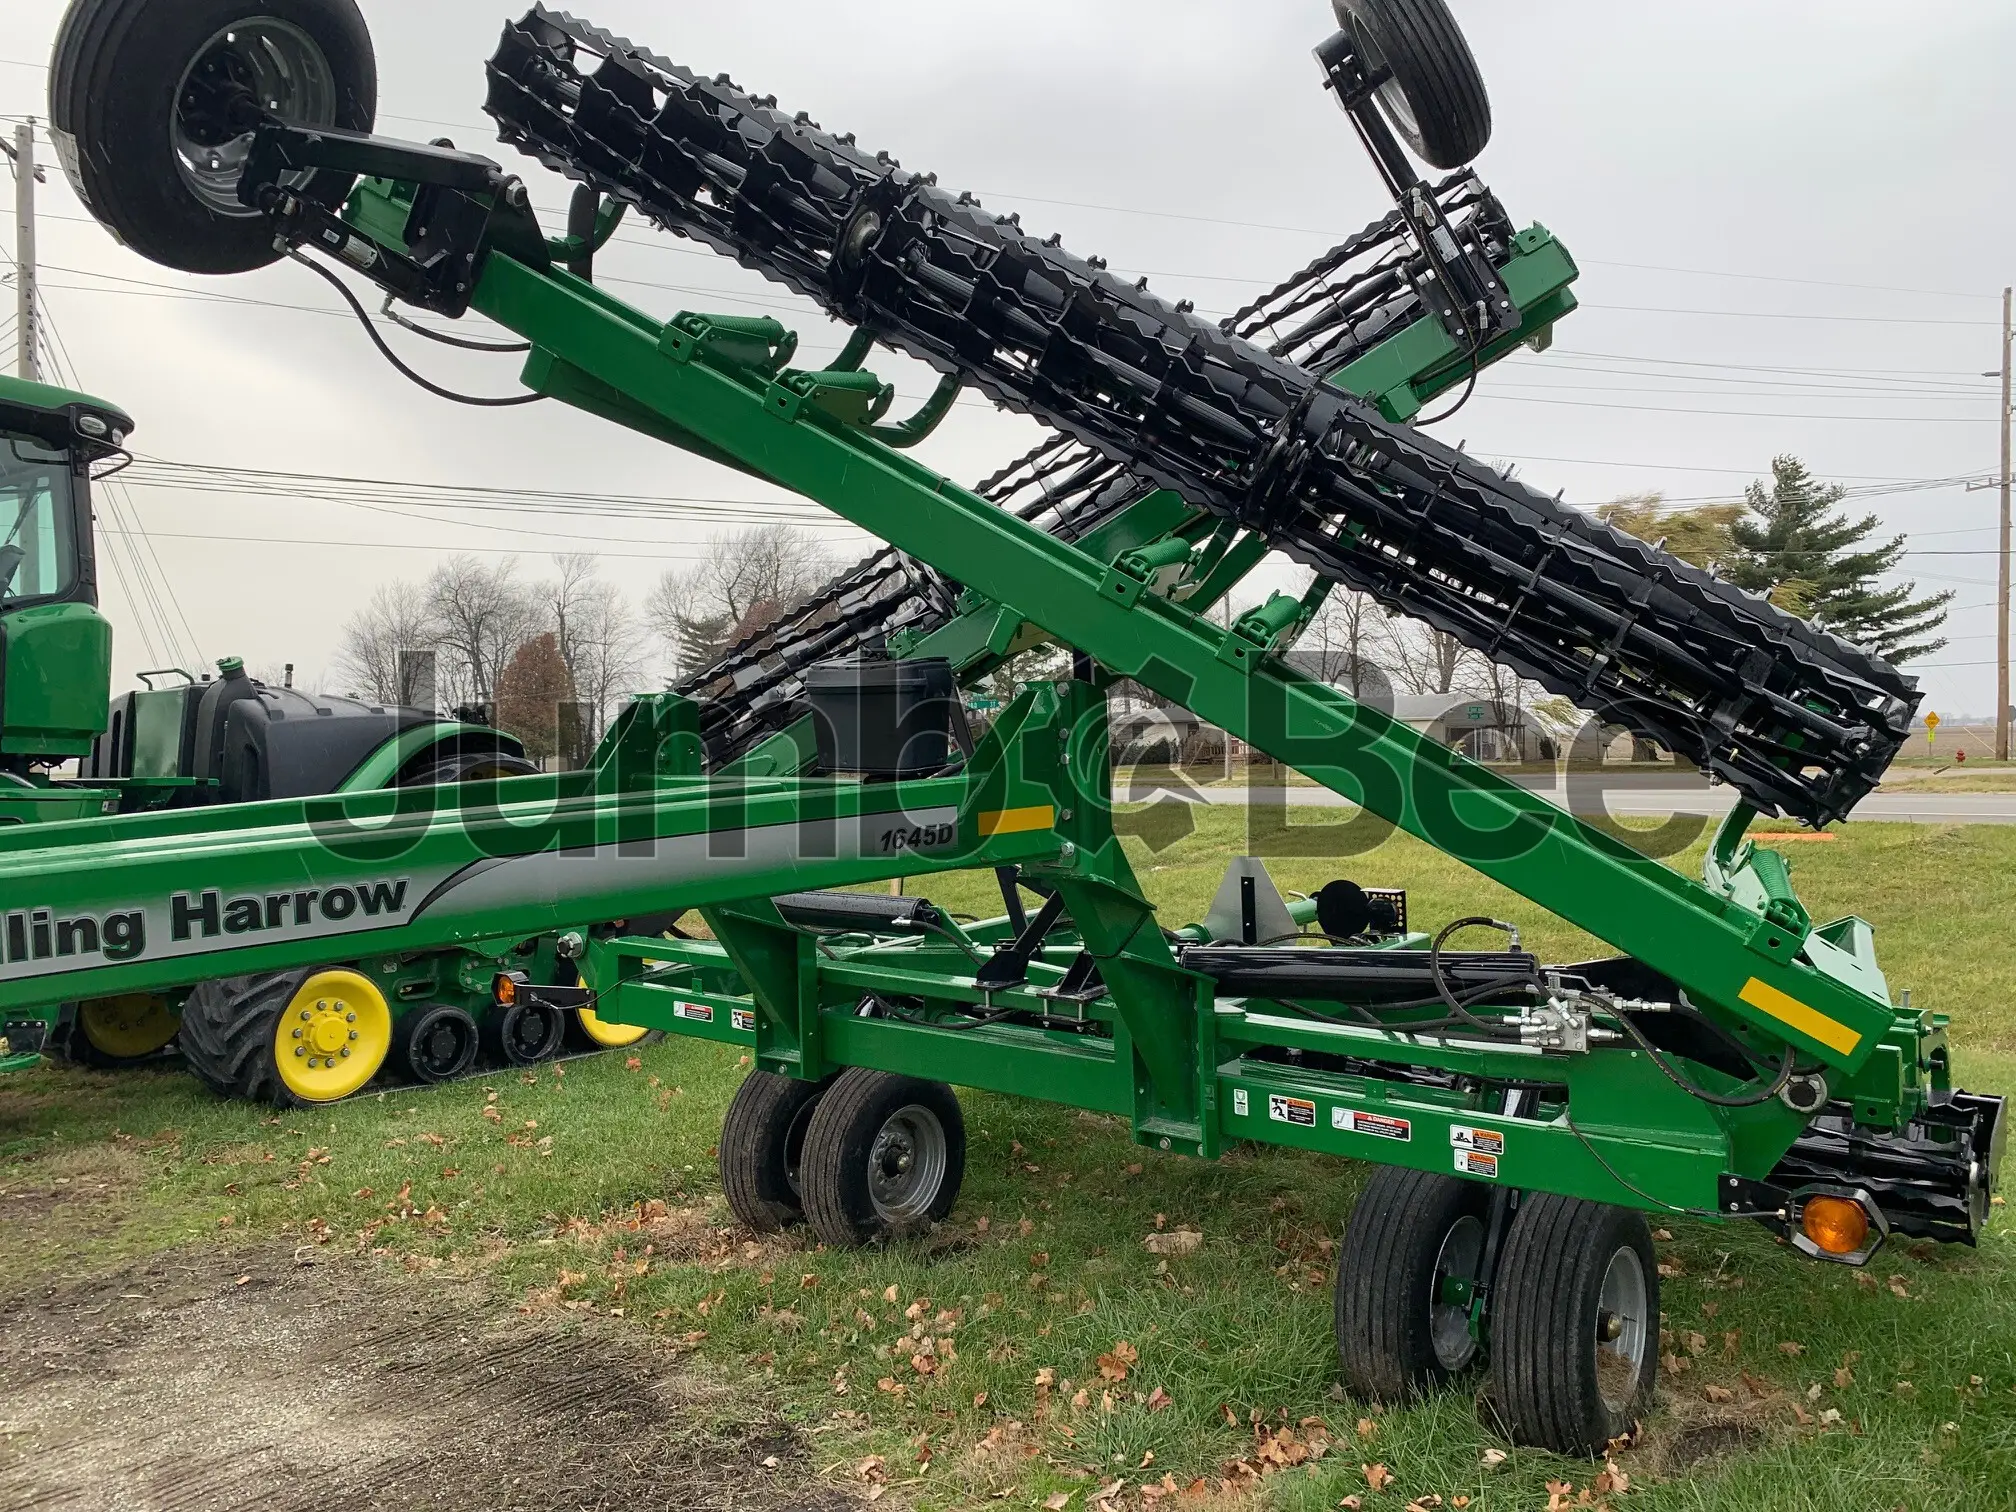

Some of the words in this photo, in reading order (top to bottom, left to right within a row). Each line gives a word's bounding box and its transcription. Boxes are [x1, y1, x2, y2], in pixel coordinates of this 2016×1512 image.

[881, 823, 953, 851] 1645D
[0, 908, 147, 961] ling
[170, 878, 409, 941] Harrow
[1372, 1116, 1395, 1126] DANGER
